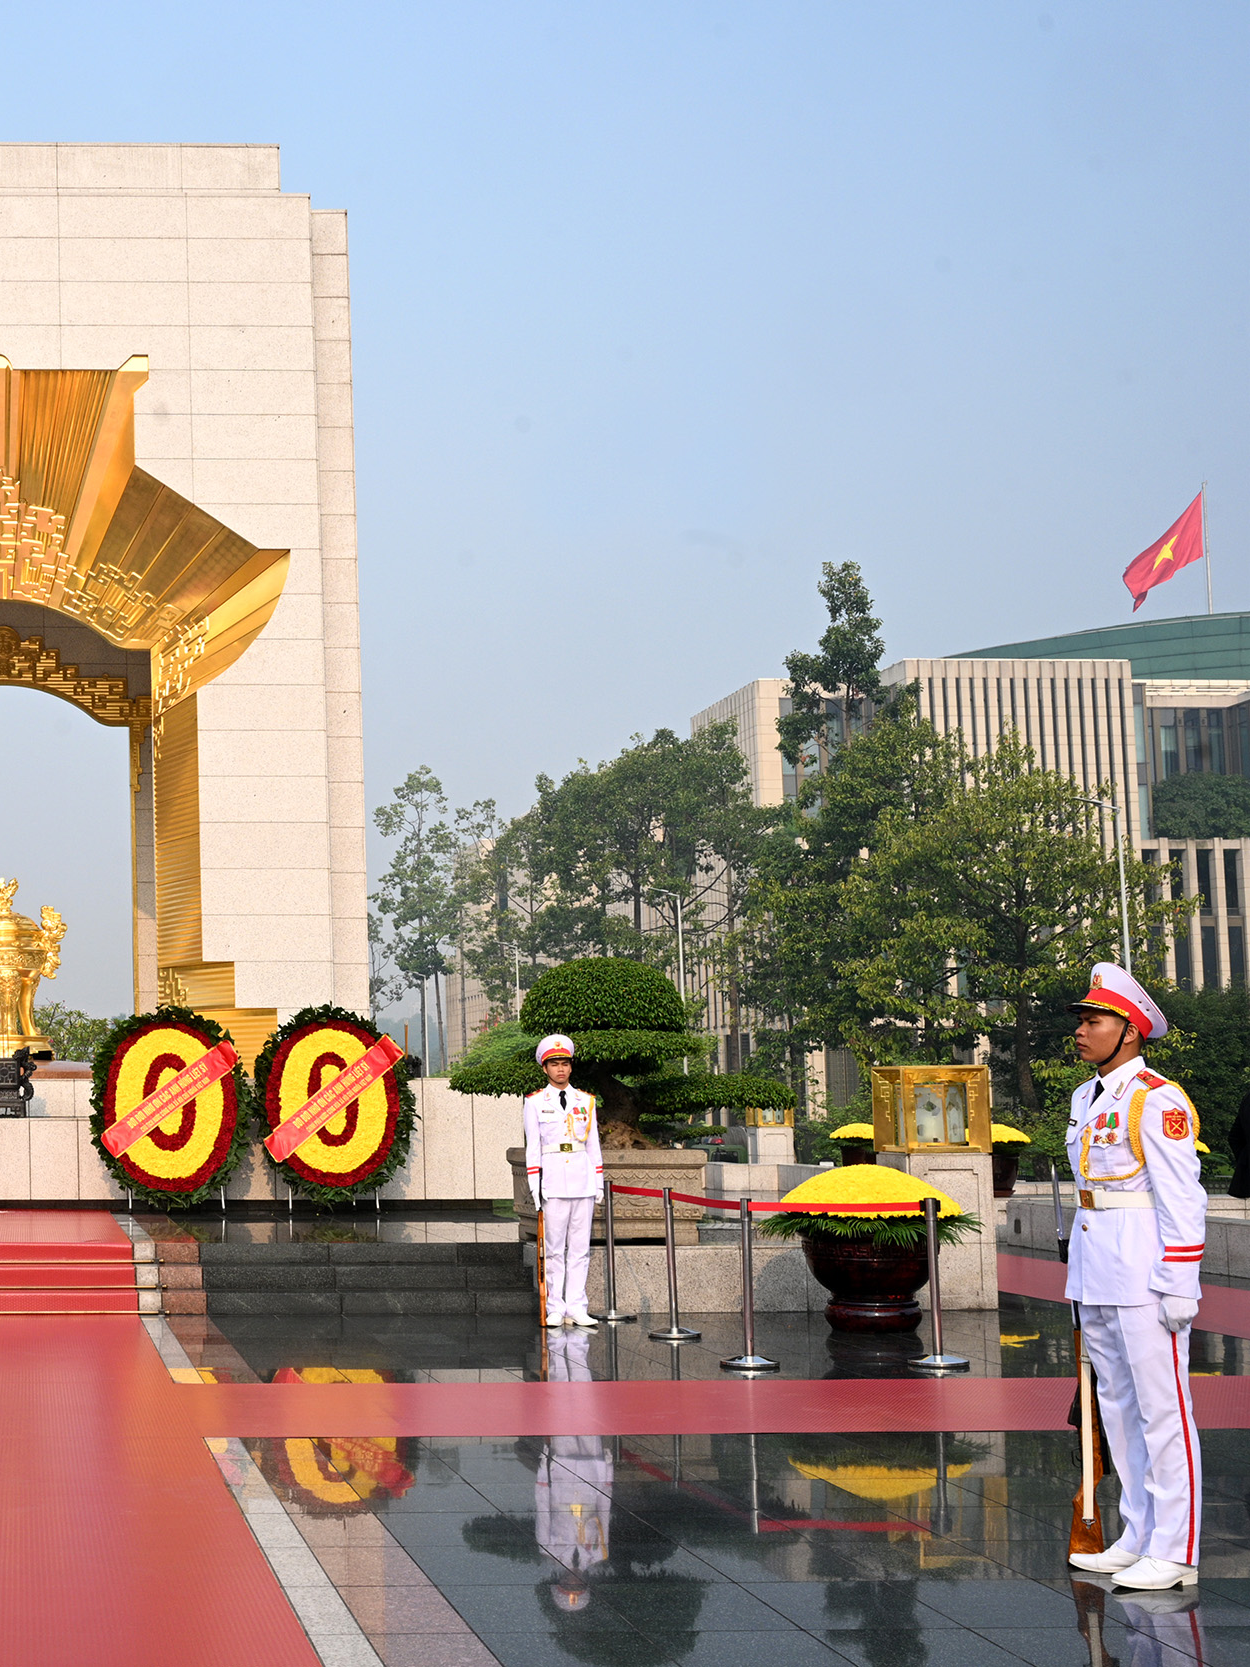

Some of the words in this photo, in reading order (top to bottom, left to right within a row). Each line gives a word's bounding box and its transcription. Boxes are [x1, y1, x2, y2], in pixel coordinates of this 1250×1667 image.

[158, 1090, 172, 1103] CÁC
[189, 1067, 202, 1079] LIỆT
[323, 1089, 336, 1102] CÁC
[351, 1066, 364, 1078] LIỆT
